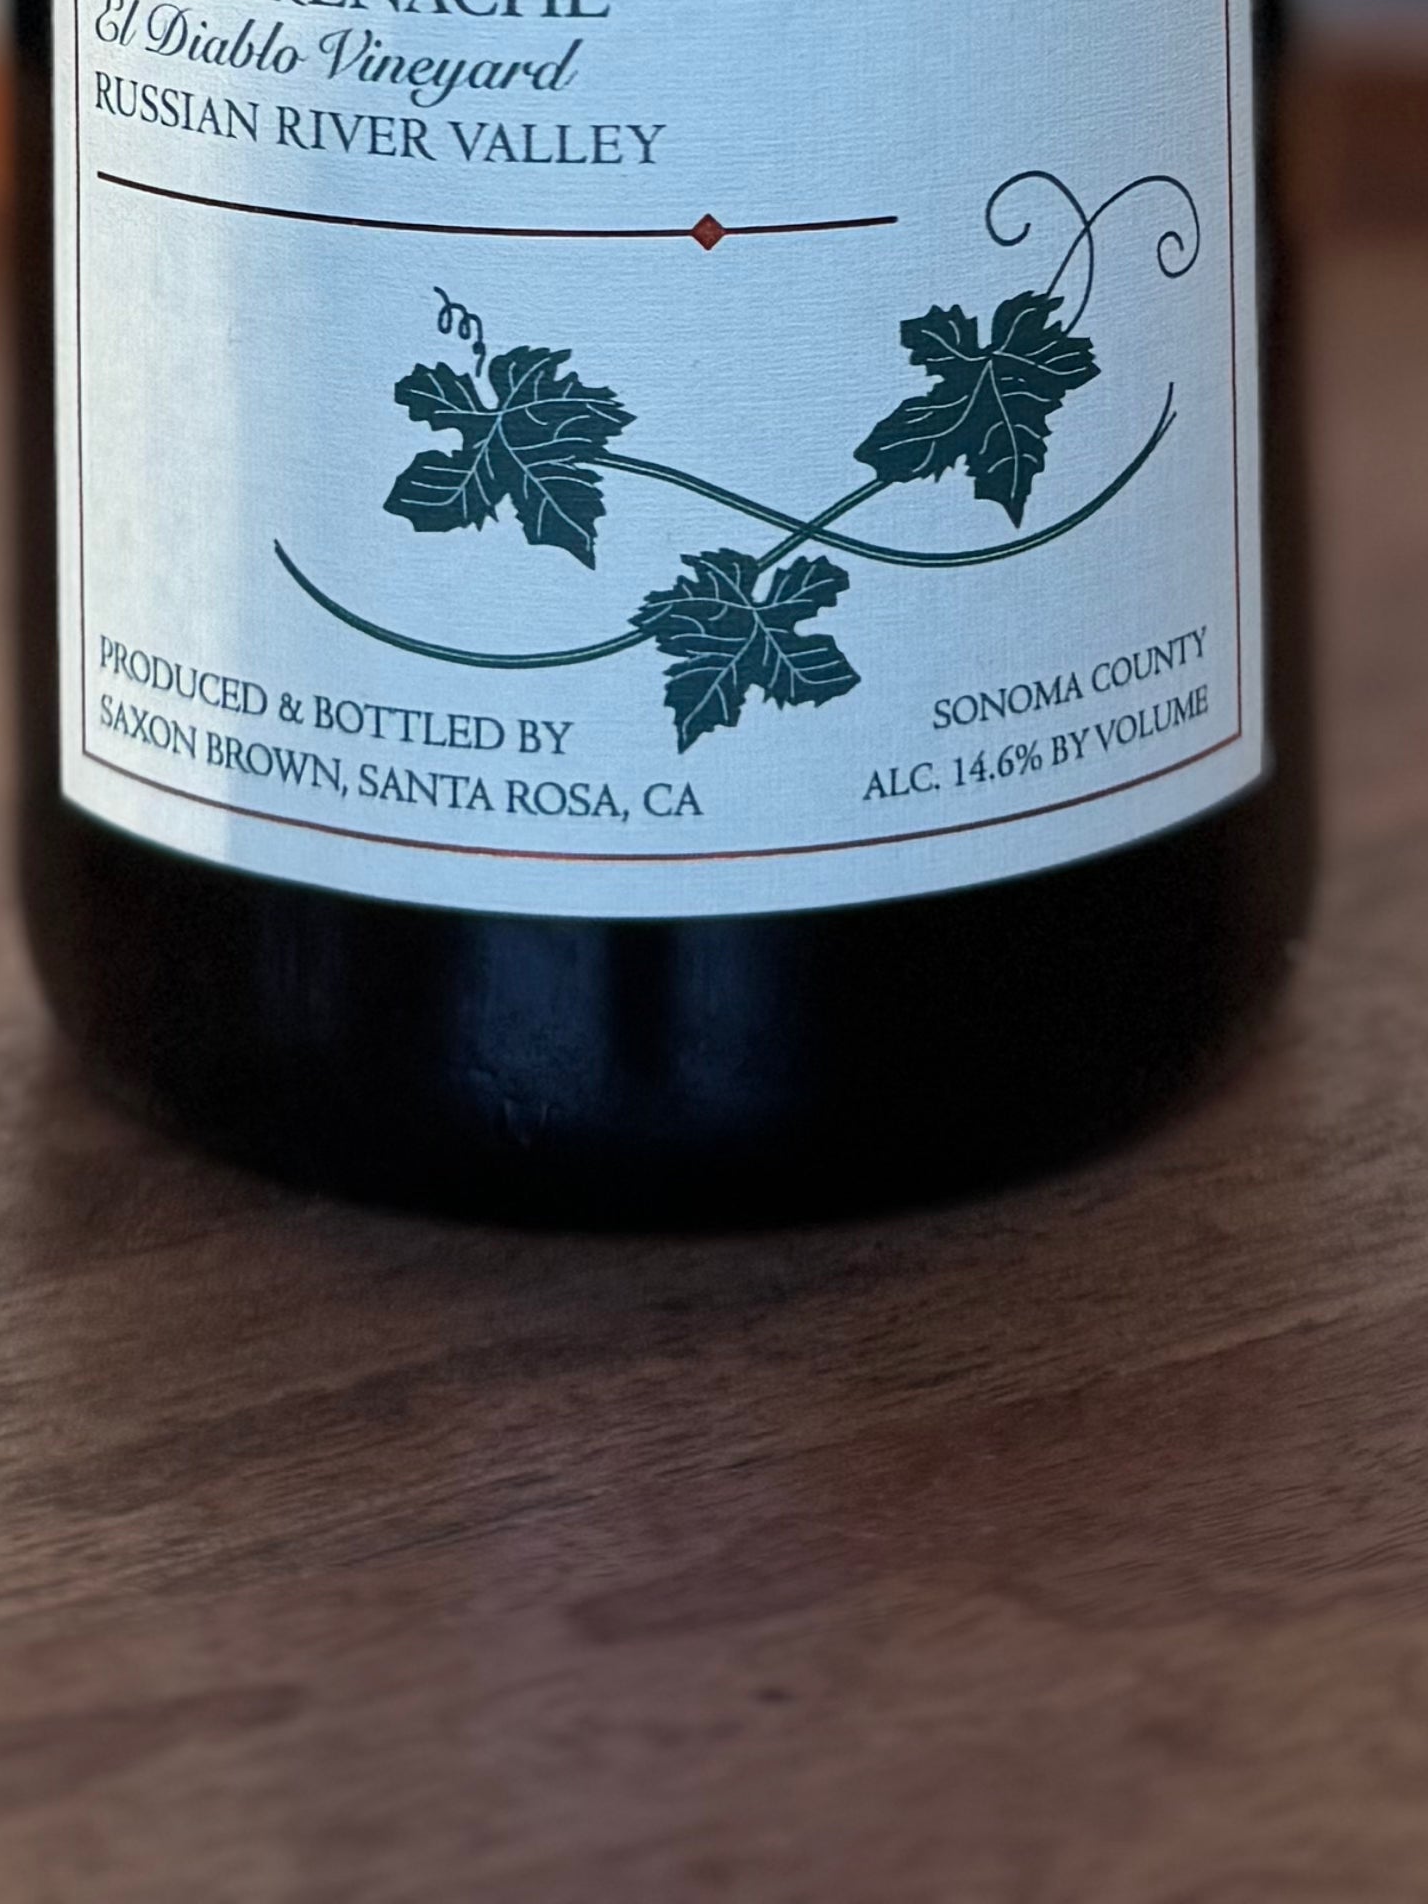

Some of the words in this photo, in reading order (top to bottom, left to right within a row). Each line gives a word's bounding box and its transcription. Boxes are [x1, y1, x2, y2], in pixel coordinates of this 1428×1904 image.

[143, 1, 311, 76] Diablo
[316, 26, 586, 110] Vineyard
[93, 69, 262, 144] RUSSIAN
[274, 104, 439, 163] RIVER
[445, 119, 669, 166] VALLEY
[98, 633, 270, 721] PRODUCED
[276, 690, 306, 727] &
[311, 693, 507, 752] BOTTLED
[515, 717, 576, 757] BY
[931, 670, 1086, 732] SONOMA
[1089, 624, 1208, 695] COUNTY
[99, 692, 199, 761] SAXON
[205, 729, 350, 801] BROWN,
[356, 762, 497, 813] SANTA
[503, 778, 632, 826] ROSA,
[641, 780, 706, 819] CA
[860, 760, 942, 803] ALC.
[951, 738, 1045, 789] 14.6%
[1049, 725, 1092, 768] BY
[1092, 682, 1210, 754] VOLUME
